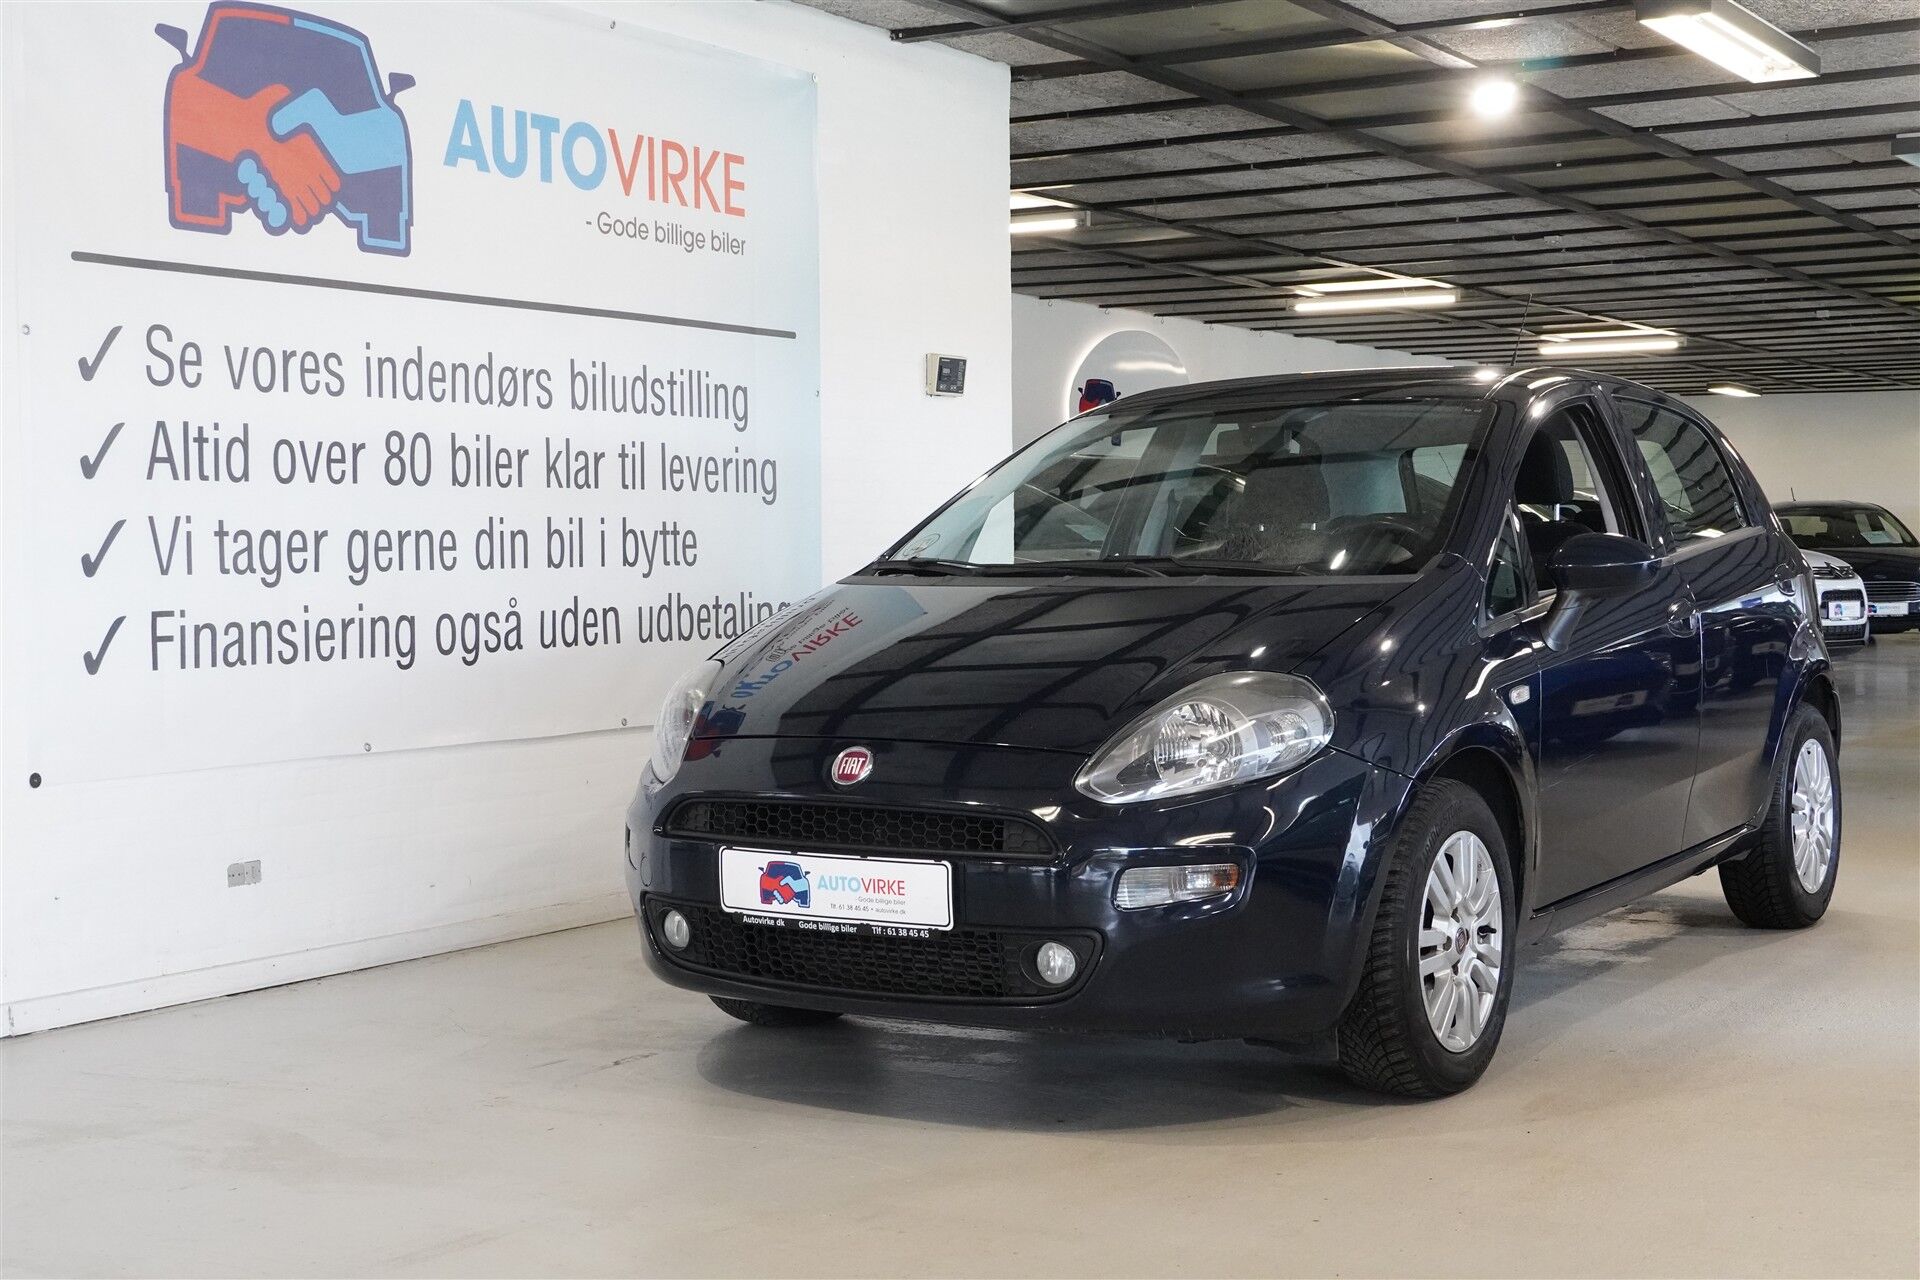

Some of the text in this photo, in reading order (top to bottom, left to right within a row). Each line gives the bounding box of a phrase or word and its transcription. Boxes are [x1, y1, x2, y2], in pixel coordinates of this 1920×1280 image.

[443, 98, 746, 217] AUTOVIRKE
[597, 211, 649, 241] Gode
[654, 220, 706, 254] billige
[711, 229, 746, 256] biler
[146, 324, 749, 433] Se vores indendørs biludstilling
[146, 420, 778, 506] Altid over 80 biler klar til levering
[148, 515, 699, 590] Vi tager gerne din bil i bytte
[150, 601, 417, 673] Finansiering
[435, 597, 525, 669] også
[539, 595, 622, 650] uden
[637, 591, 791, 644] udbetalin
[838, 757, 866, 775] FIAT
[817, 875, 906, 896] AUTOVIRKE
[799, 920, 858, 934] Gode billige biler
[887, 927, 897, 936] 61
[898, 928, 908, 937] 38
[909, 929, 919, 938] 45
[920, 930, 930, 938] 45
